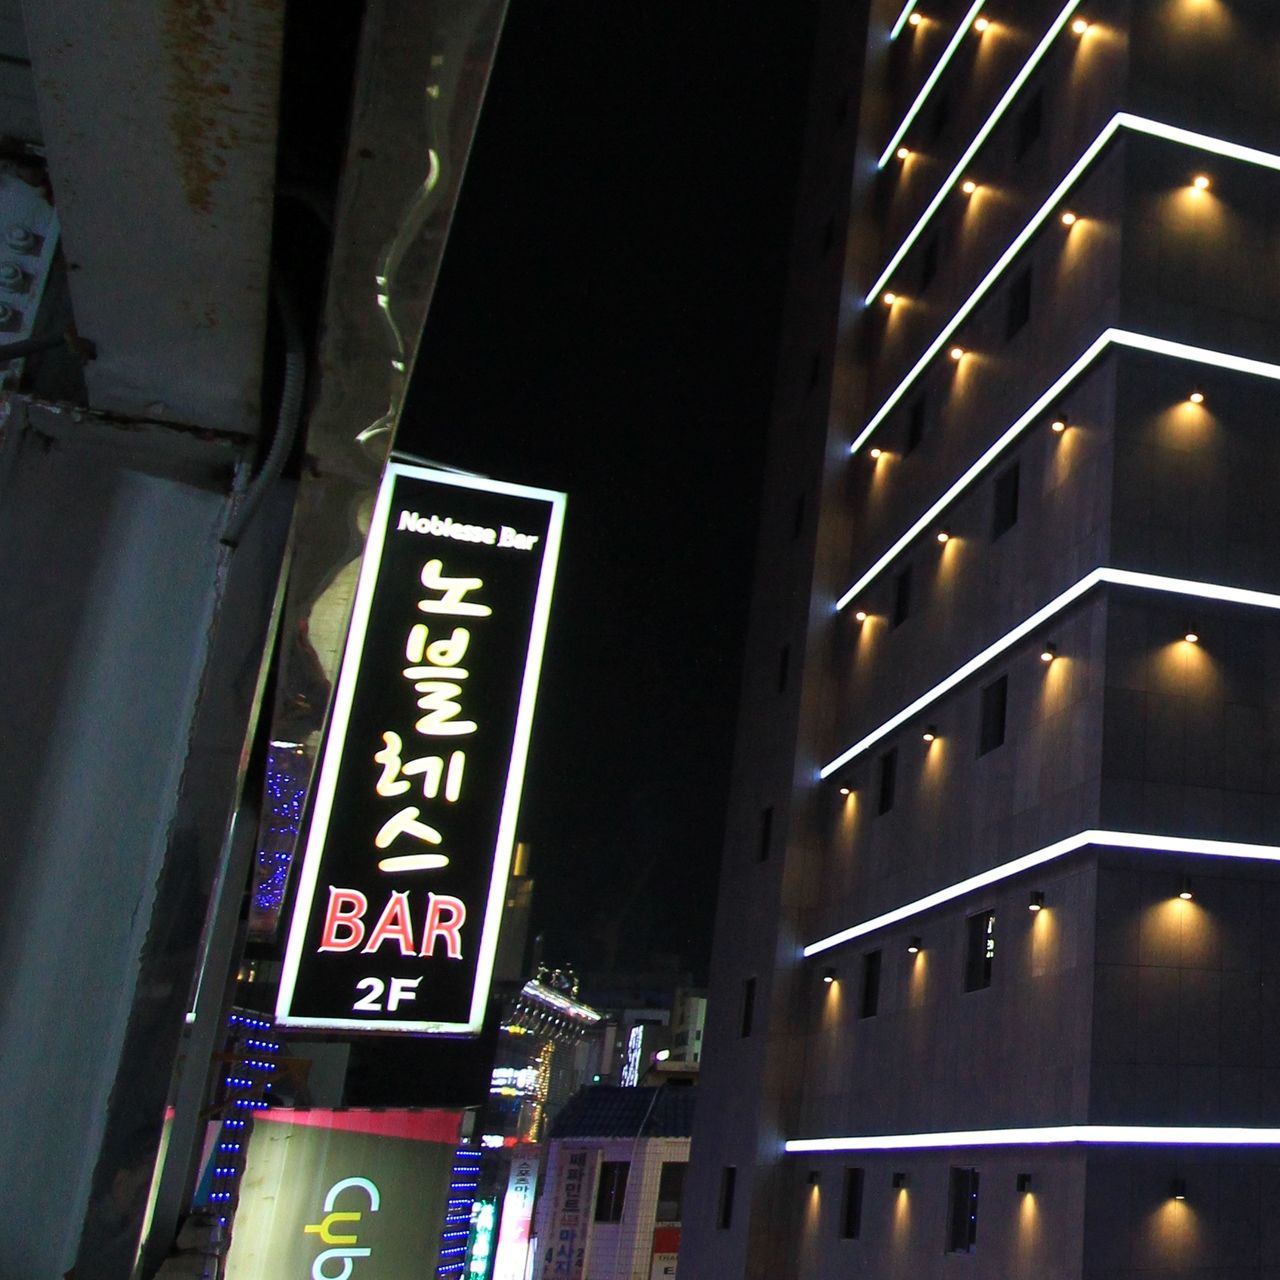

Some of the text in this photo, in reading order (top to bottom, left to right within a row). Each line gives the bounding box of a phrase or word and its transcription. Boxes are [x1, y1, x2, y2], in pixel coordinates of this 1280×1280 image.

[397, 510, 539, 551] Noblesse Bar
[374, 558, 492, 872] 노블레스
[317, 884, 467, 961] BAR
[353, 975, 423, 1012] 2F
